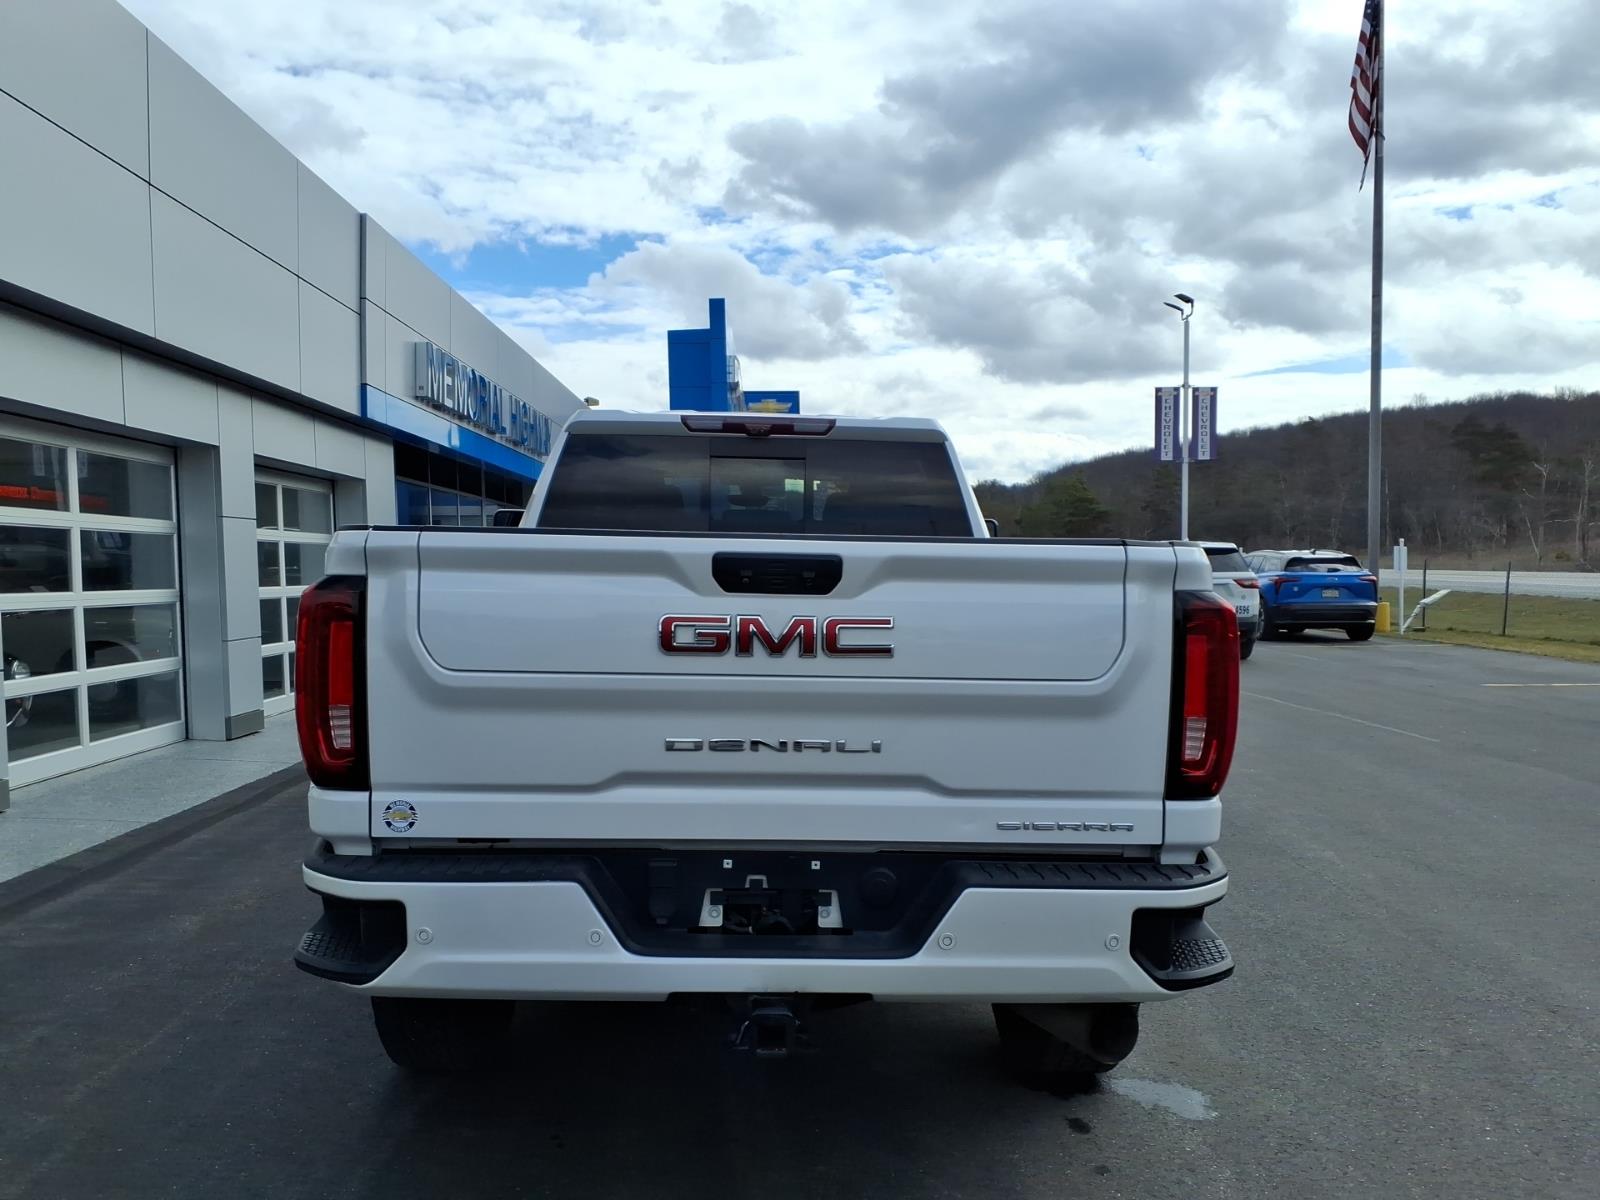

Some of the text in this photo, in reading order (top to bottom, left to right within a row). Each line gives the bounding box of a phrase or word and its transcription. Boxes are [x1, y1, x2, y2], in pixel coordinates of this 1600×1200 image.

[426, 342, 507, 436] MEMORIAL
[1163, 398, 1172, 457] CHEVROLET
[1200, 398, 1209, 457] CHEVROLET
[658, 614, 894, 658] GMC
[664, 737, 882, 753] DENALI
[996, 821, 1134, 832] SIERRA
